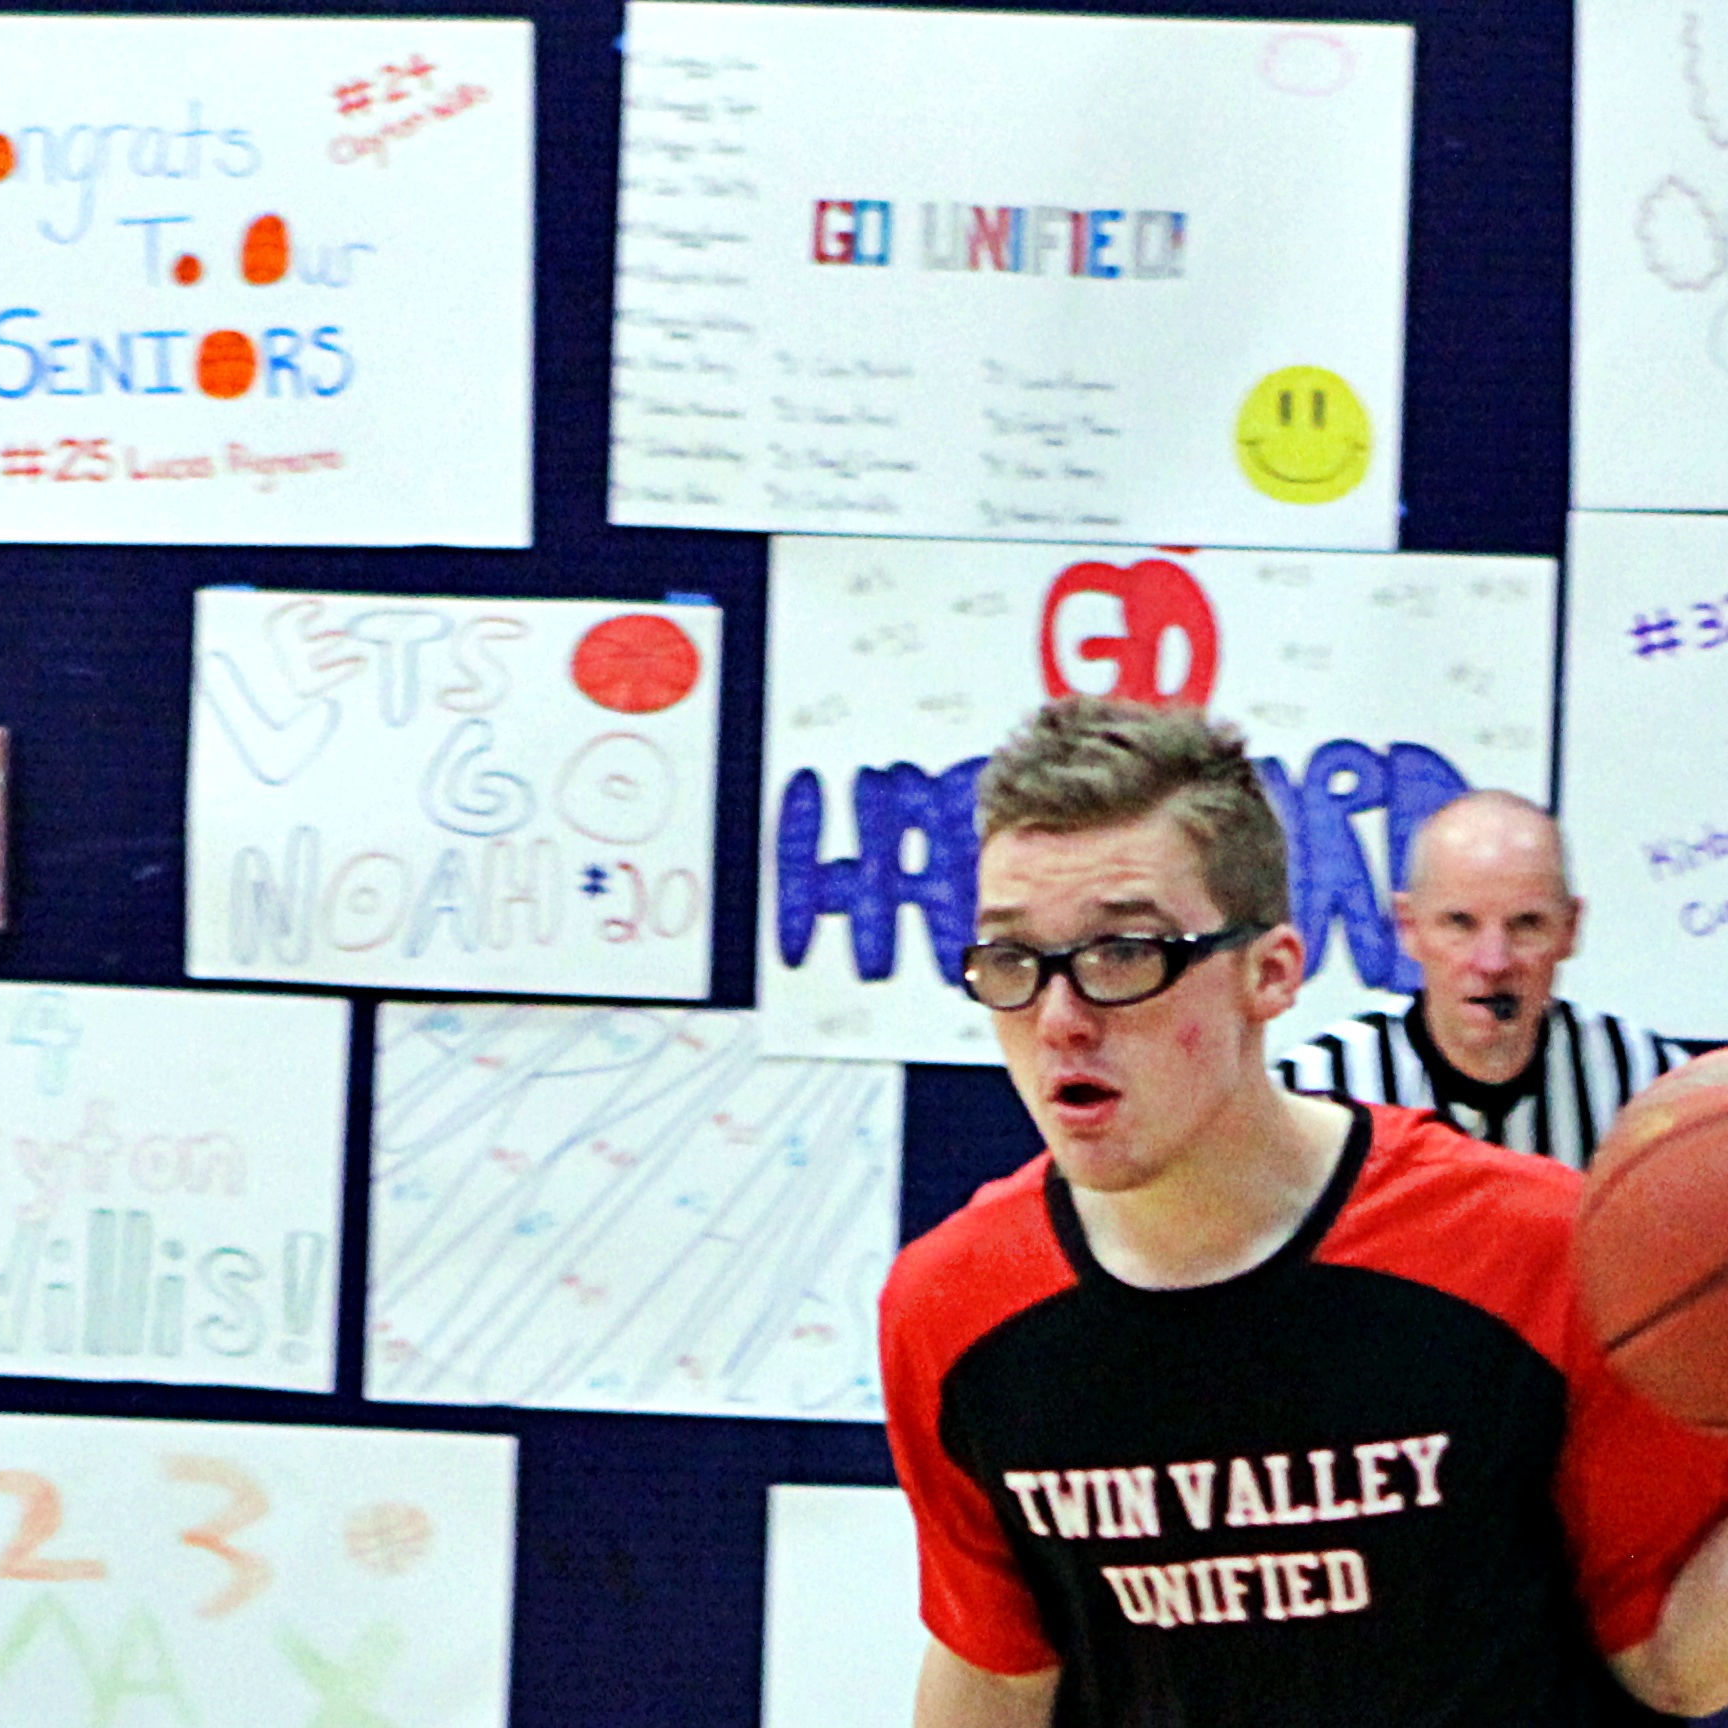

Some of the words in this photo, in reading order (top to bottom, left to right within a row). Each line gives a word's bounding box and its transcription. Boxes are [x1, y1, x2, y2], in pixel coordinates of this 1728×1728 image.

[811, 198, 892, 267] GO
[1038, 557, 1223, 708] GO
[418, 718, 679, 846] GO
[229, 825, 565, 967] NOAH
[1003, 1467, 1161, 1541] TWIN
[1168, 1432, 1452, 1532] VALLEY
[1101, 1549, 1373, 1630] UNIFIED
